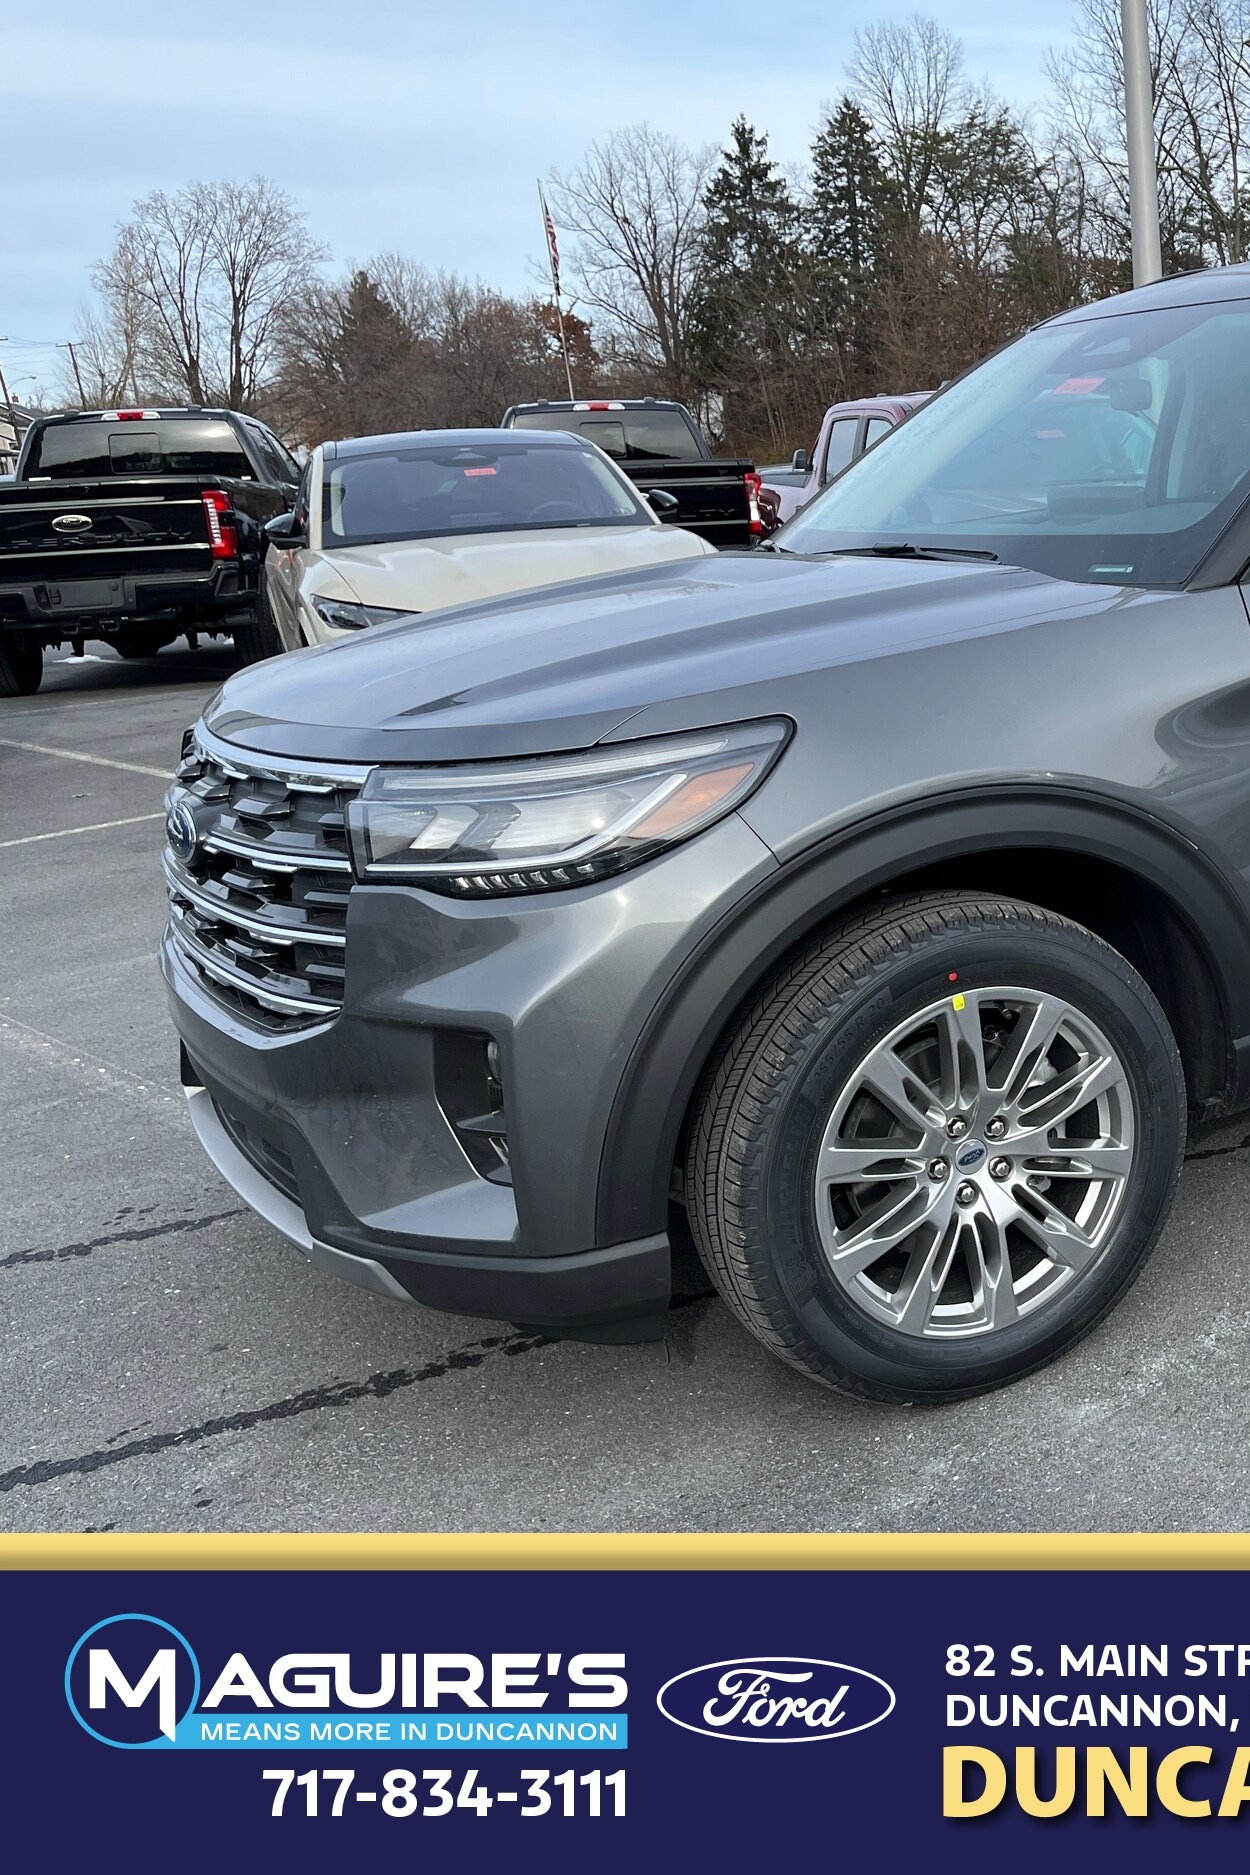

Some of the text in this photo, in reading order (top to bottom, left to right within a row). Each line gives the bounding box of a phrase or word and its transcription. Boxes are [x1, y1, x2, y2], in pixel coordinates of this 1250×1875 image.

[812, 1028, 854, 1087] 255/55
[854, 1014, 865, 1031] R
[868, 997, 885, 1019] 20
